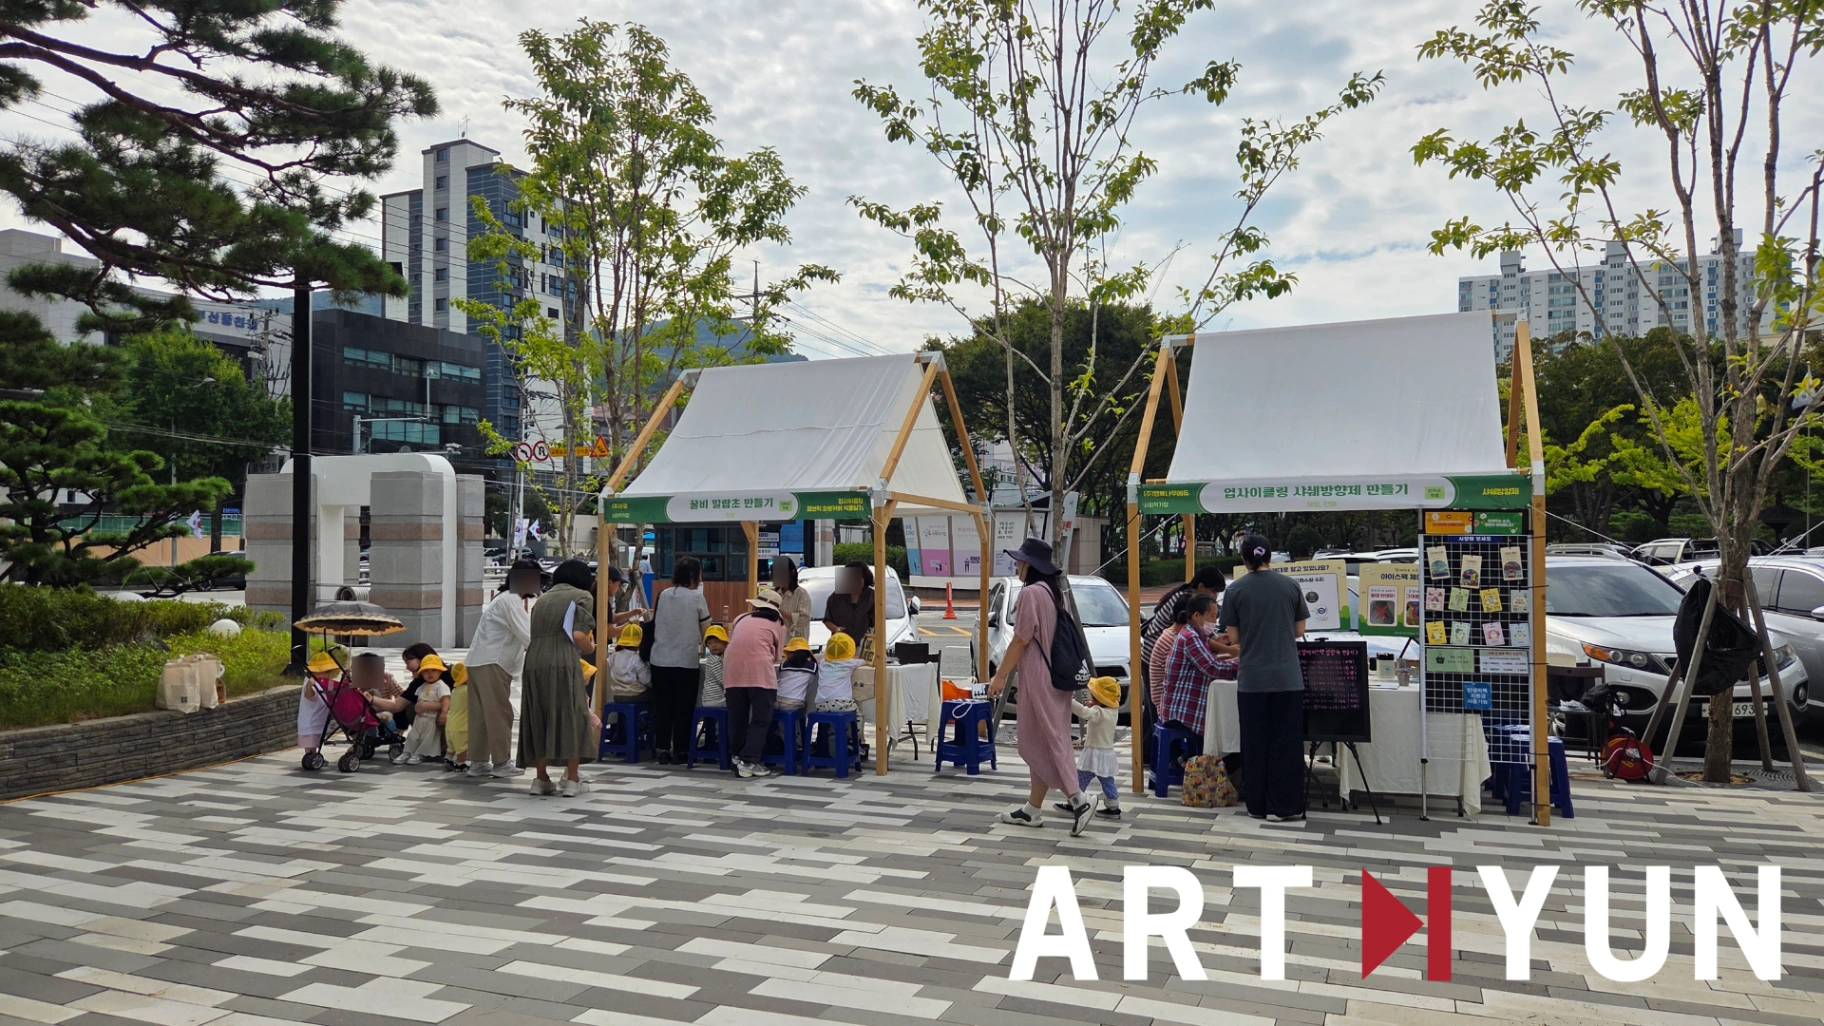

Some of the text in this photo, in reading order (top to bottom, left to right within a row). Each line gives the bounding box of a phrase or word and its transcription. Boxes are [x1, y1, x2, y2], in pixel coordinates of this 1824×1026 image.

[1224, 483, 1408, 499] 업사이클링 샤쉐방향제 만들기
[690, 499, 708, 510] 꿀비
[744, 497, 773, 508] 만들기
